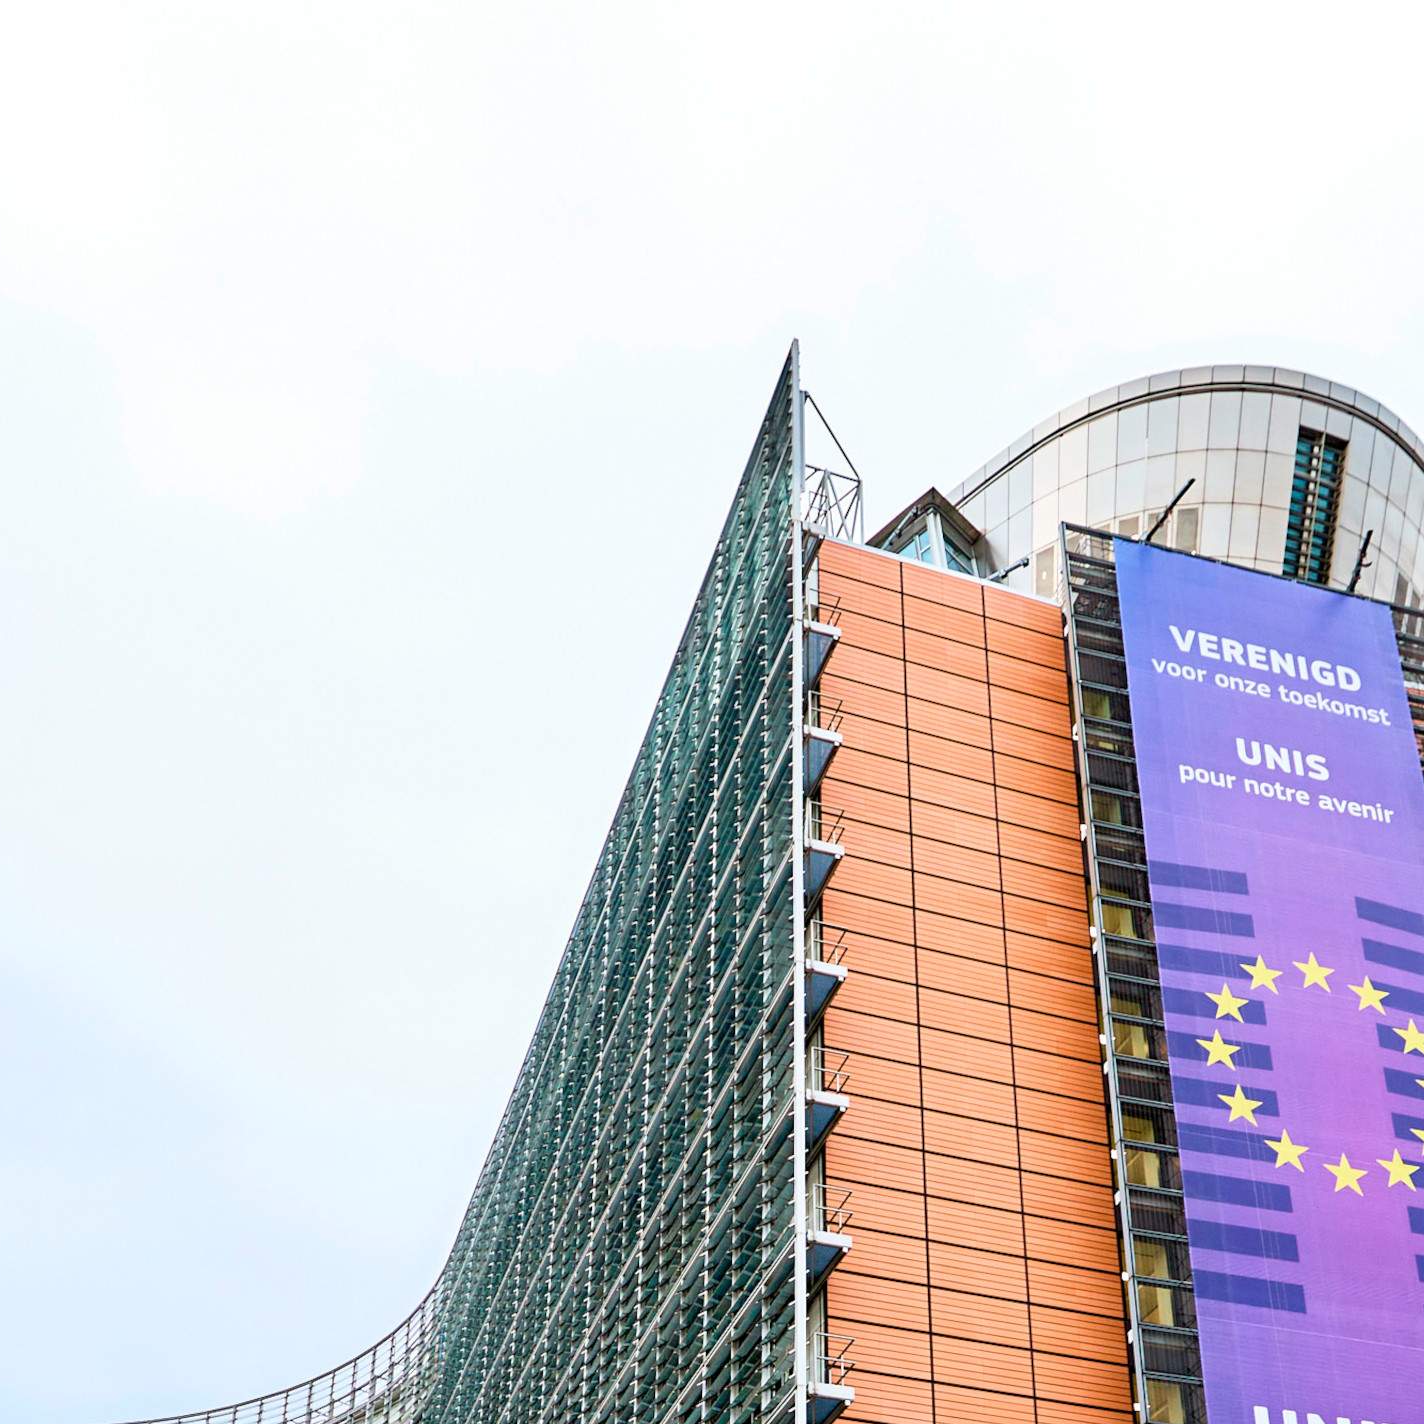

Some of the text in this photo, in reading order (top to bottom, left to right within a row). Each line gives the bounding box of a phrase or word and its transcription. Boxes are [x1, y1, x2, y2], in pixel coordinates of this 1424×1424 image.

[1169, 624, 1362, 692] VERENIGD
[1151, 657, 1391, 727] voor onze toekomst
[1235, 736, 1330, 782] UNIS
[1179, 763, 1395, 824] pour notre avenir
